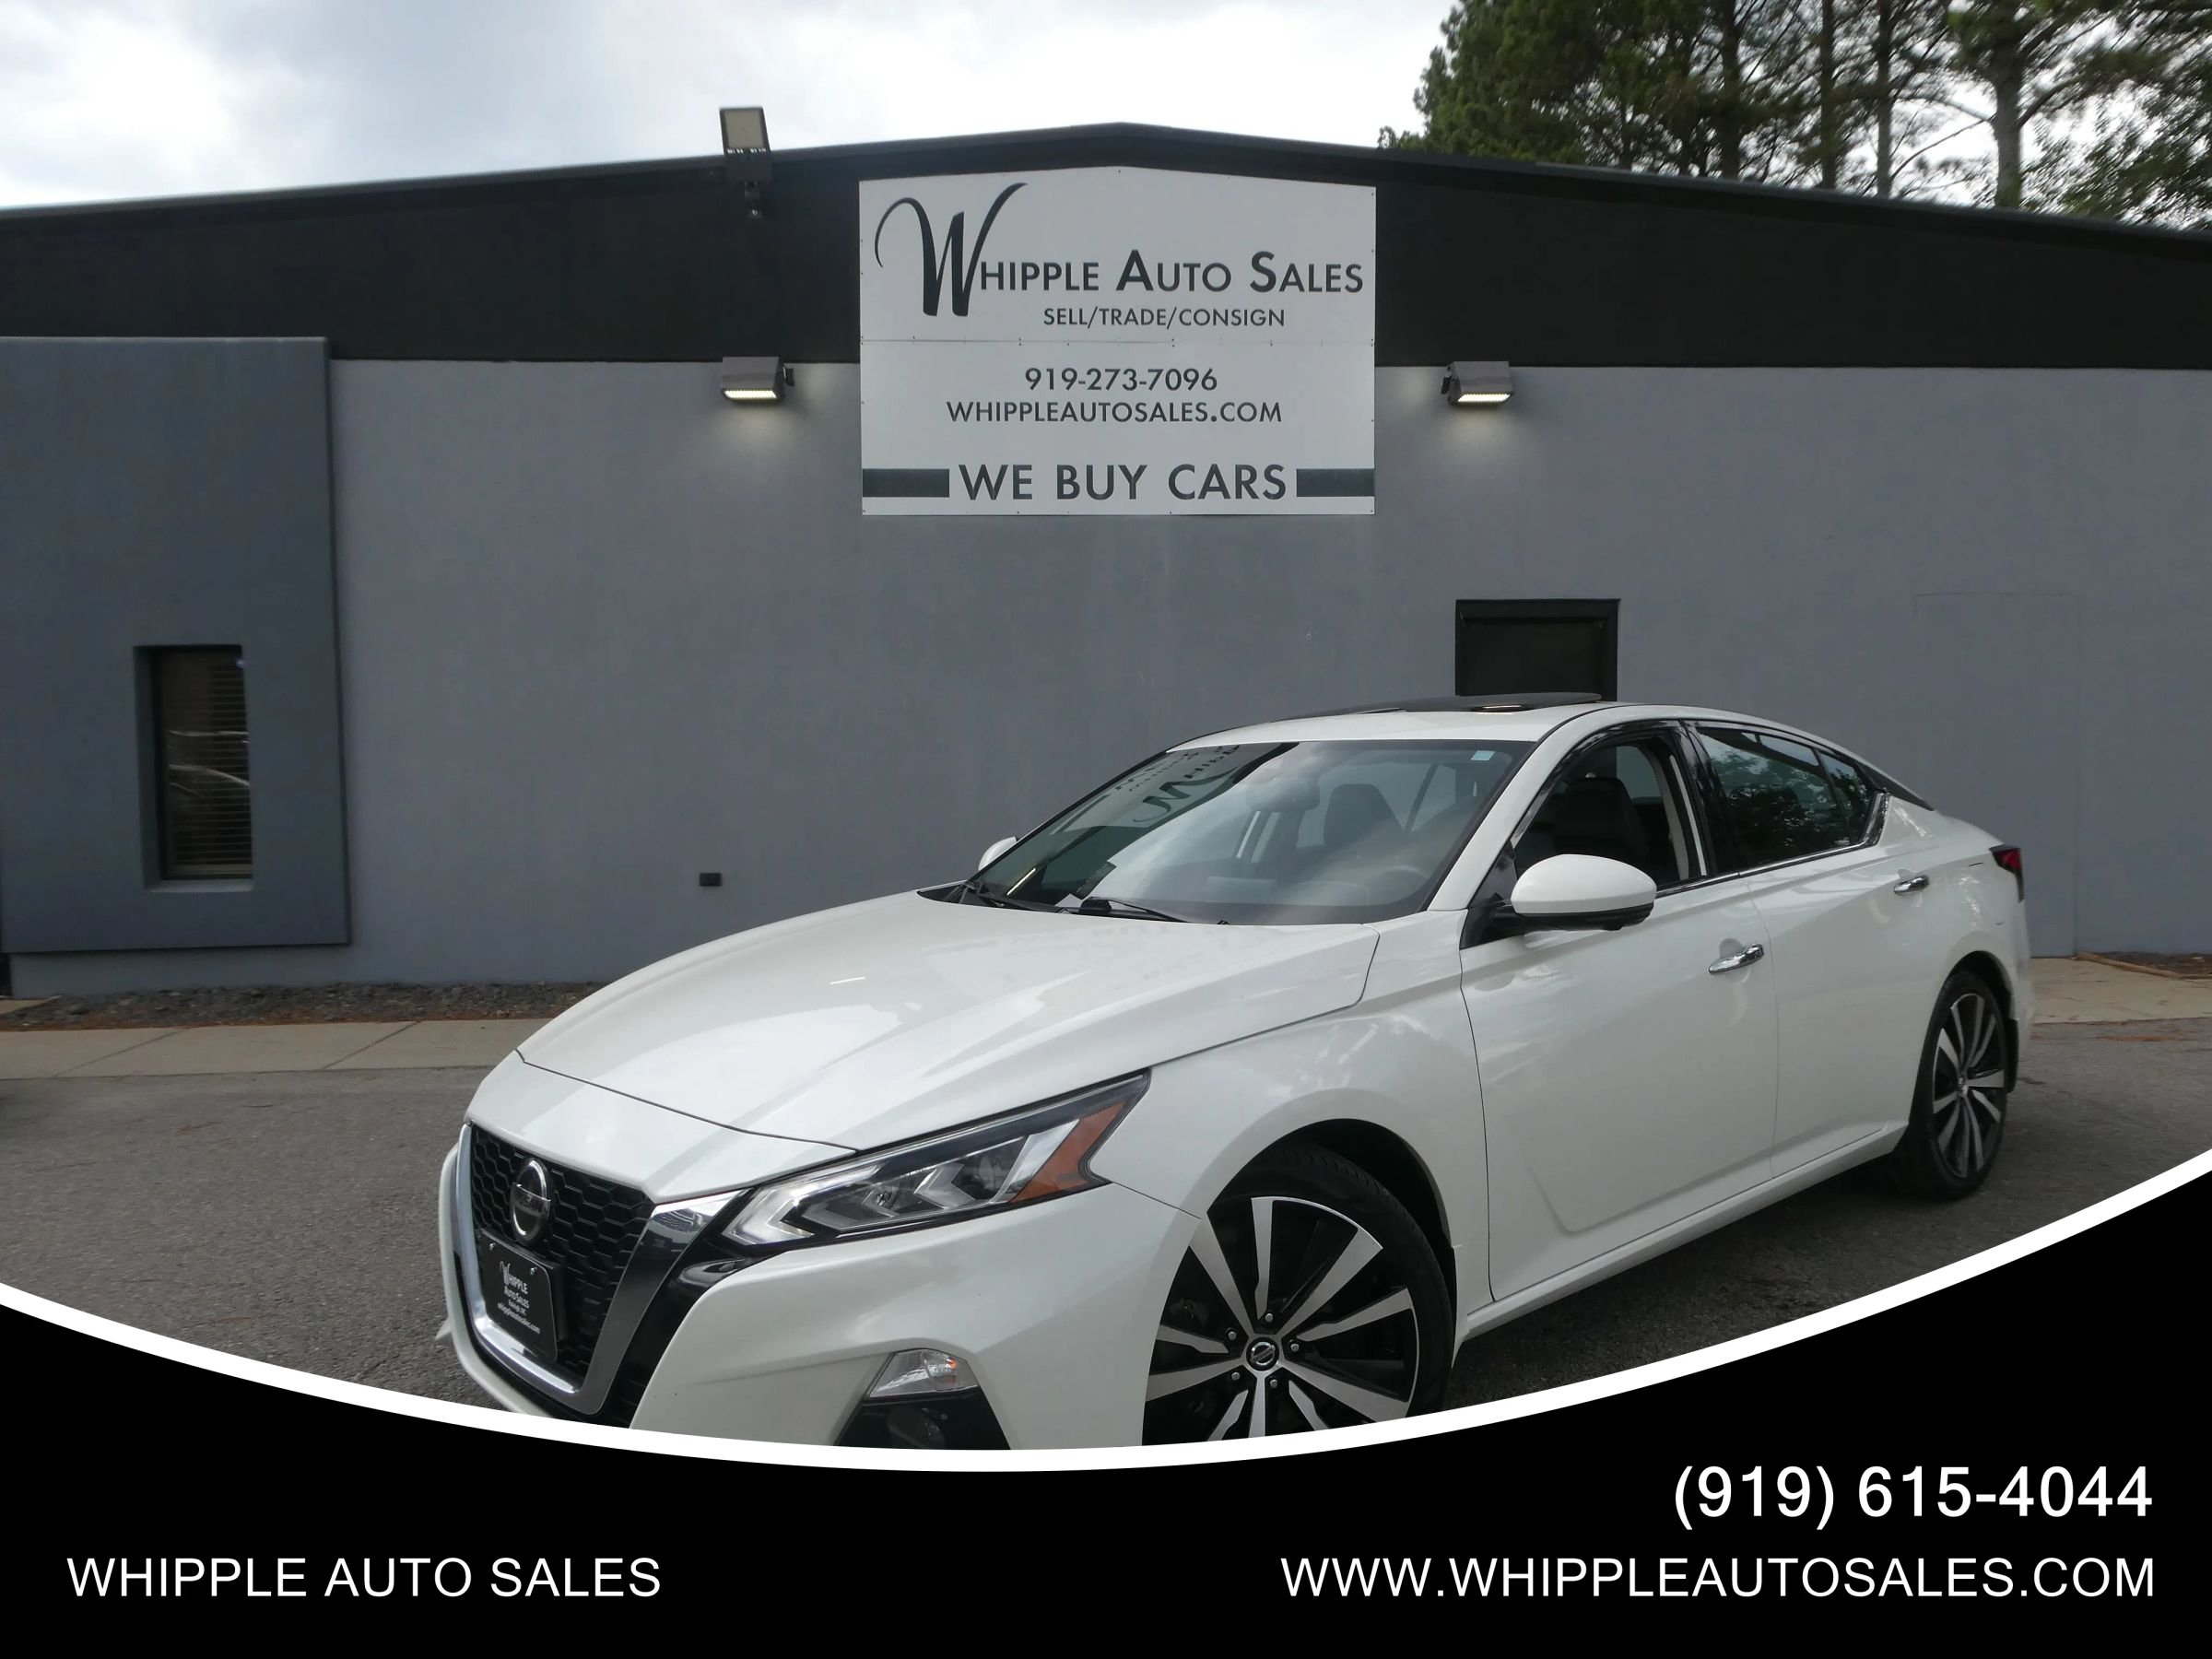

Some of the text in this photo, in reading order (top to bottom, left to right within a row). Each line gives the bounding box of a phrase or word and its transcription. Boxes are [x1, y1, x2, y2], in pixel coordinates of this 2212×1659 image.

[1115, 249, 1232, 293] AUTO
[1249, 251, 1364, 294] SALES
[1043, 306, 1286, 330] SELL/TRADE/CONSIGN
[1024, 367, 1218, 392] 919-273-7096
[946, 401, 1283, 424] WHIPPLEAUTOSALES.COM
[959, 463, 1287, 500] WE BUY CARS
